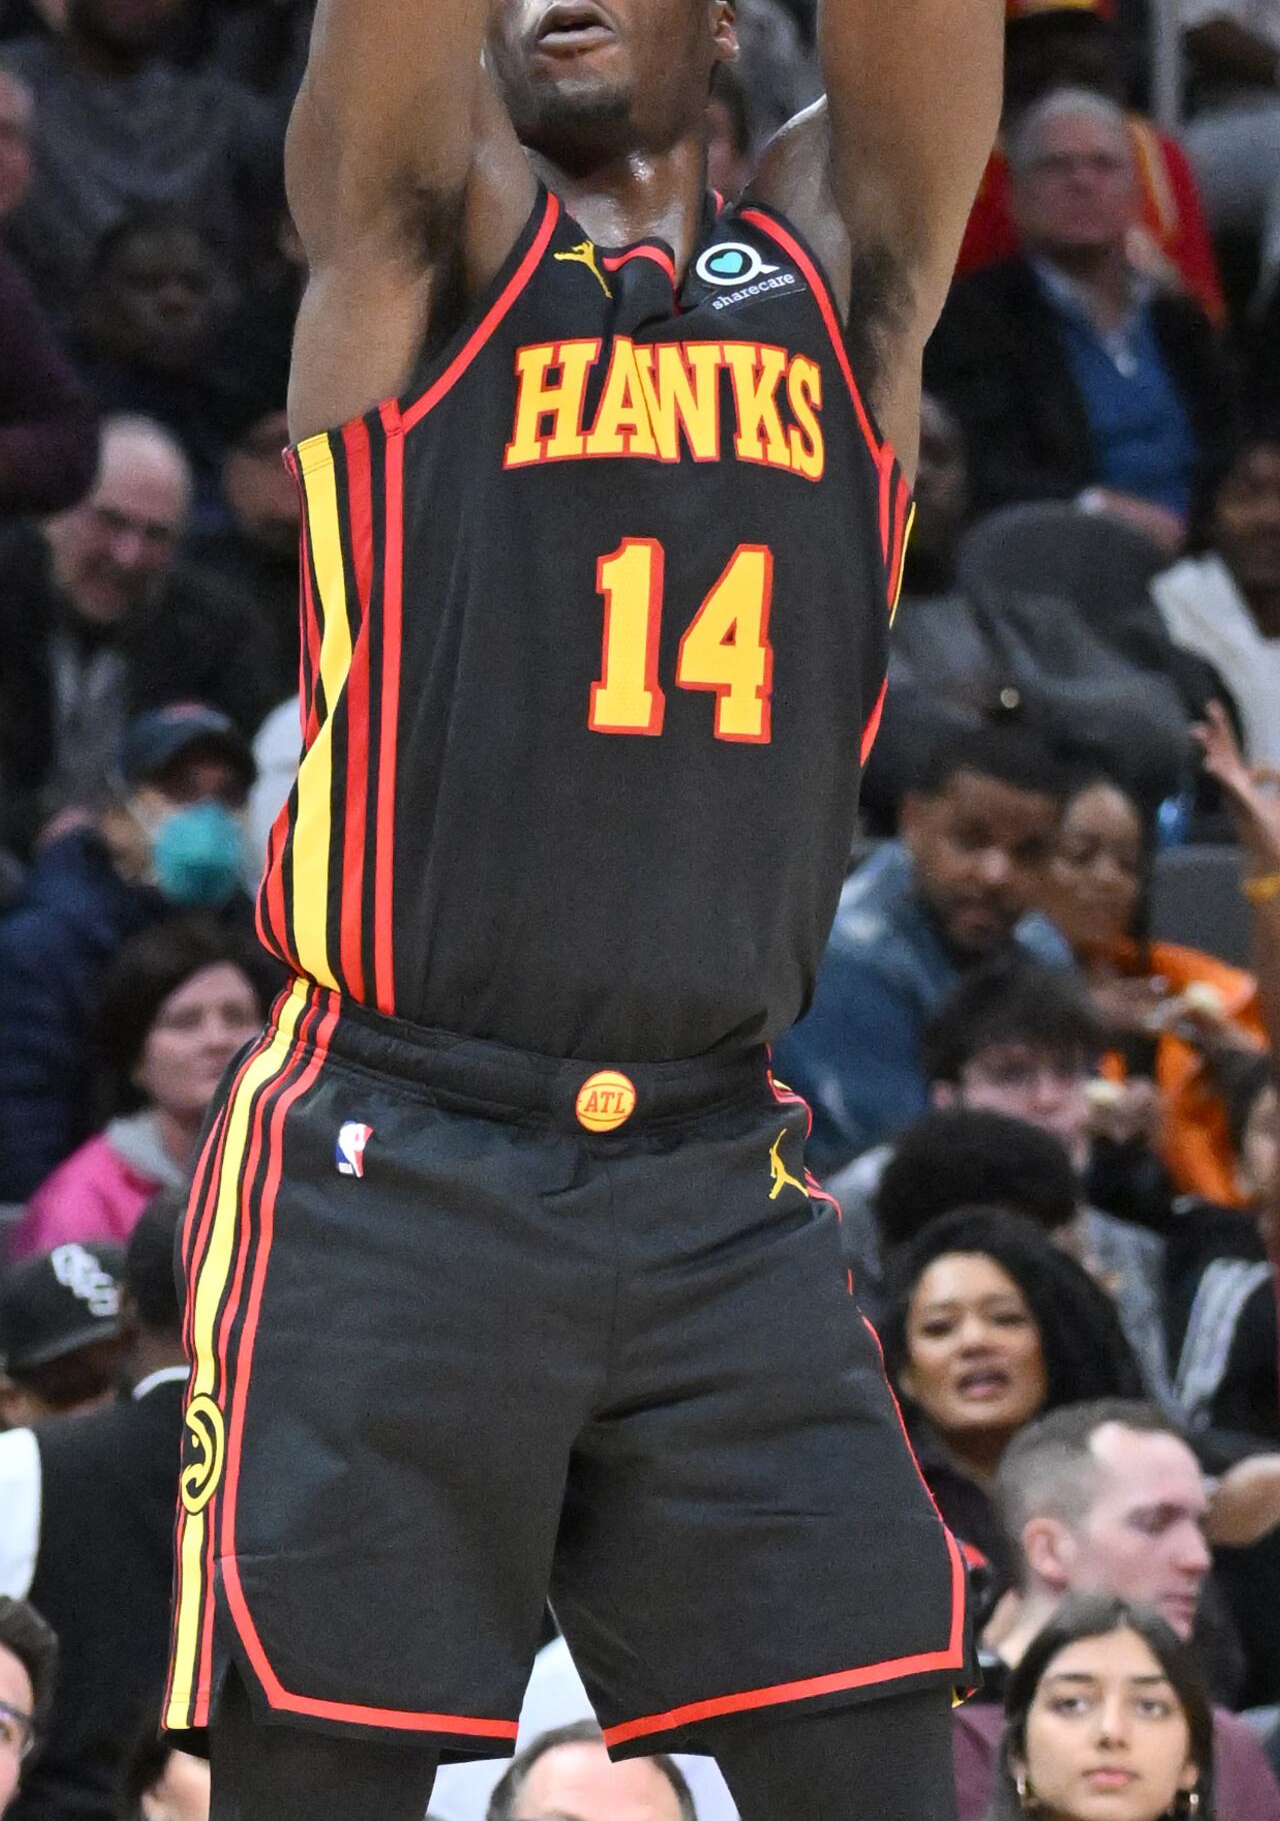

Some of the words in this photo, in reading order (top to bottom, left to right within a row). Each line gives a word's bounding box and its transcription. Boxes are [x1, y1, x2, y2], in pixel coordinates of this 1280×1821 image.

[712, 274, 795, 310] sharecare
[503, 334, 825, 482] HAWKS
[588, 536, 774, 745] 14
[583, 1090, 626, 1114] ATL
